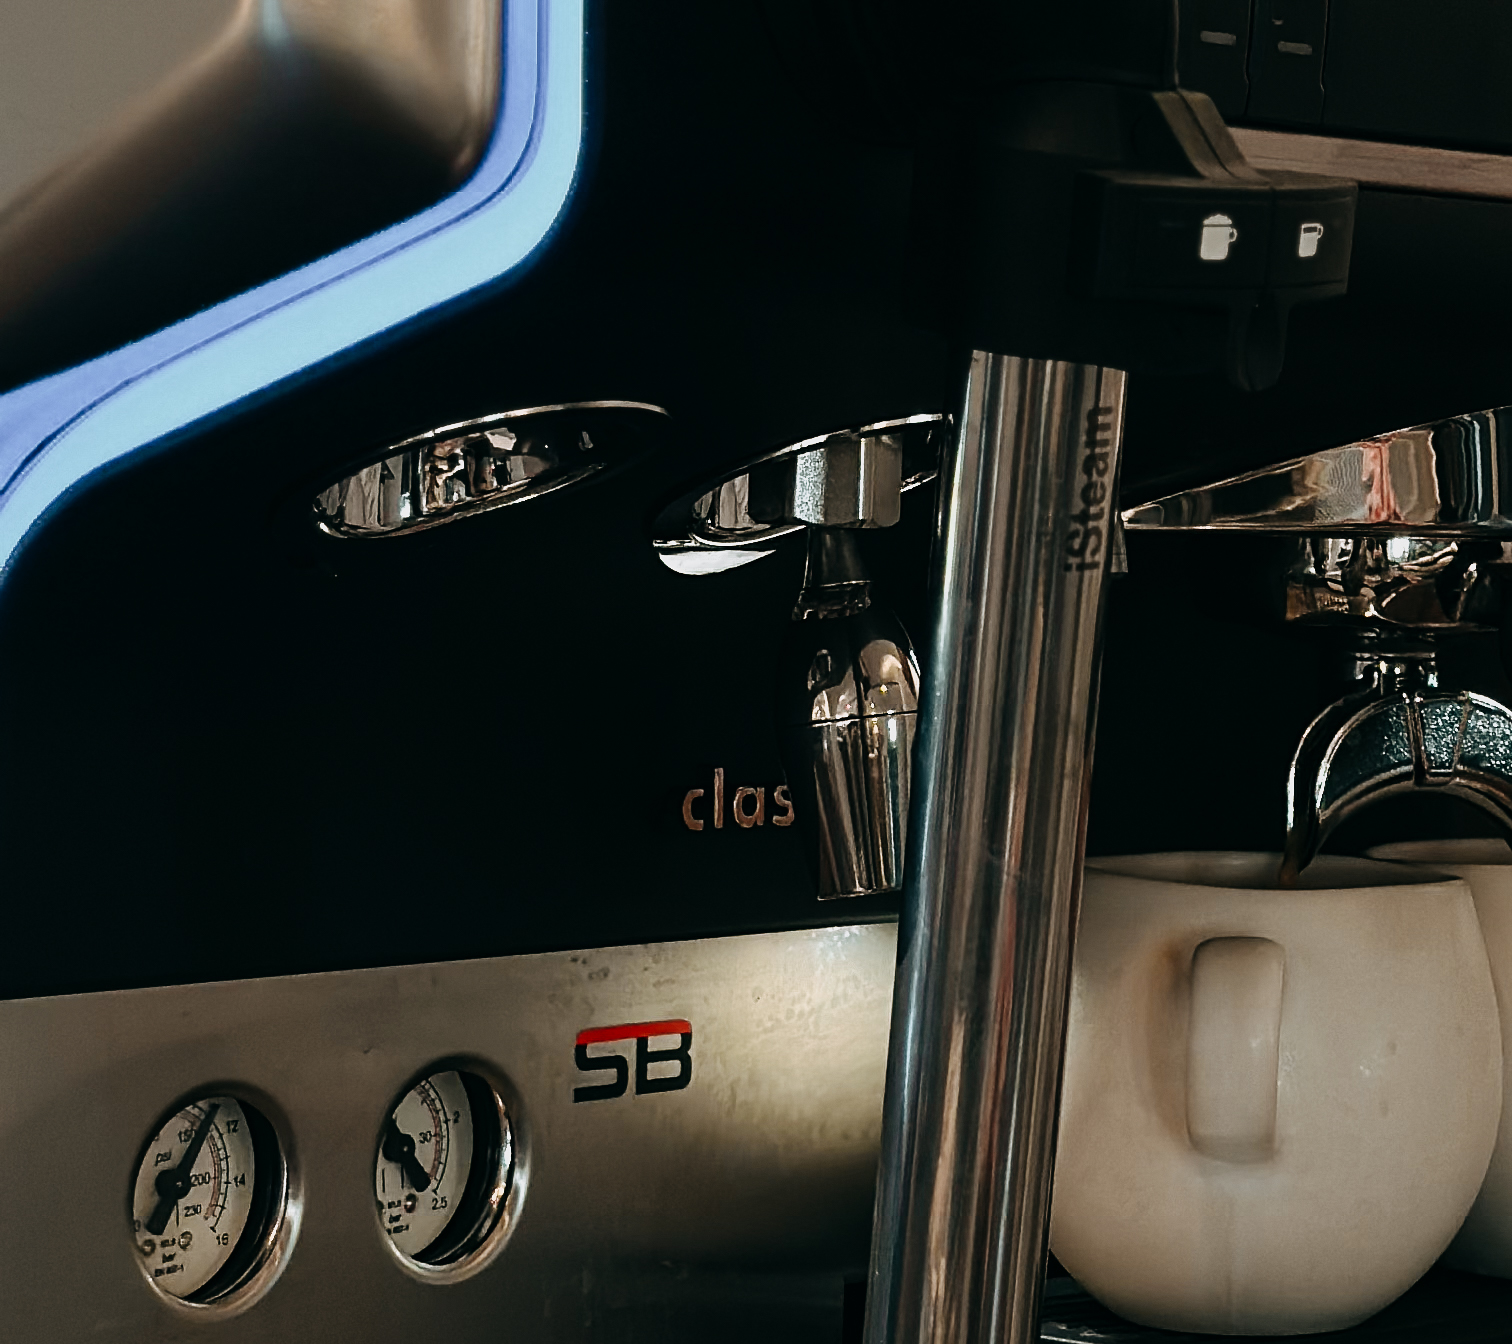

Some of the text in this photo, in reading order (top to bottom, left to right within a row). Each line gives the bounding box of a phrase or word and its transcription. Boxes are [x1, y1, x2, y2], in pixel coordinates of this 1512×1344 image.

[1063, 406, 1113, 573] iSteam
[682, 767, 795, 831] clas
[225, 1119, 240, 1134] 12
[190, 1171, 211, 1188] 200
[233, 1171, 246, 1188] 14
[215, 1233, 229, 1246] 16
